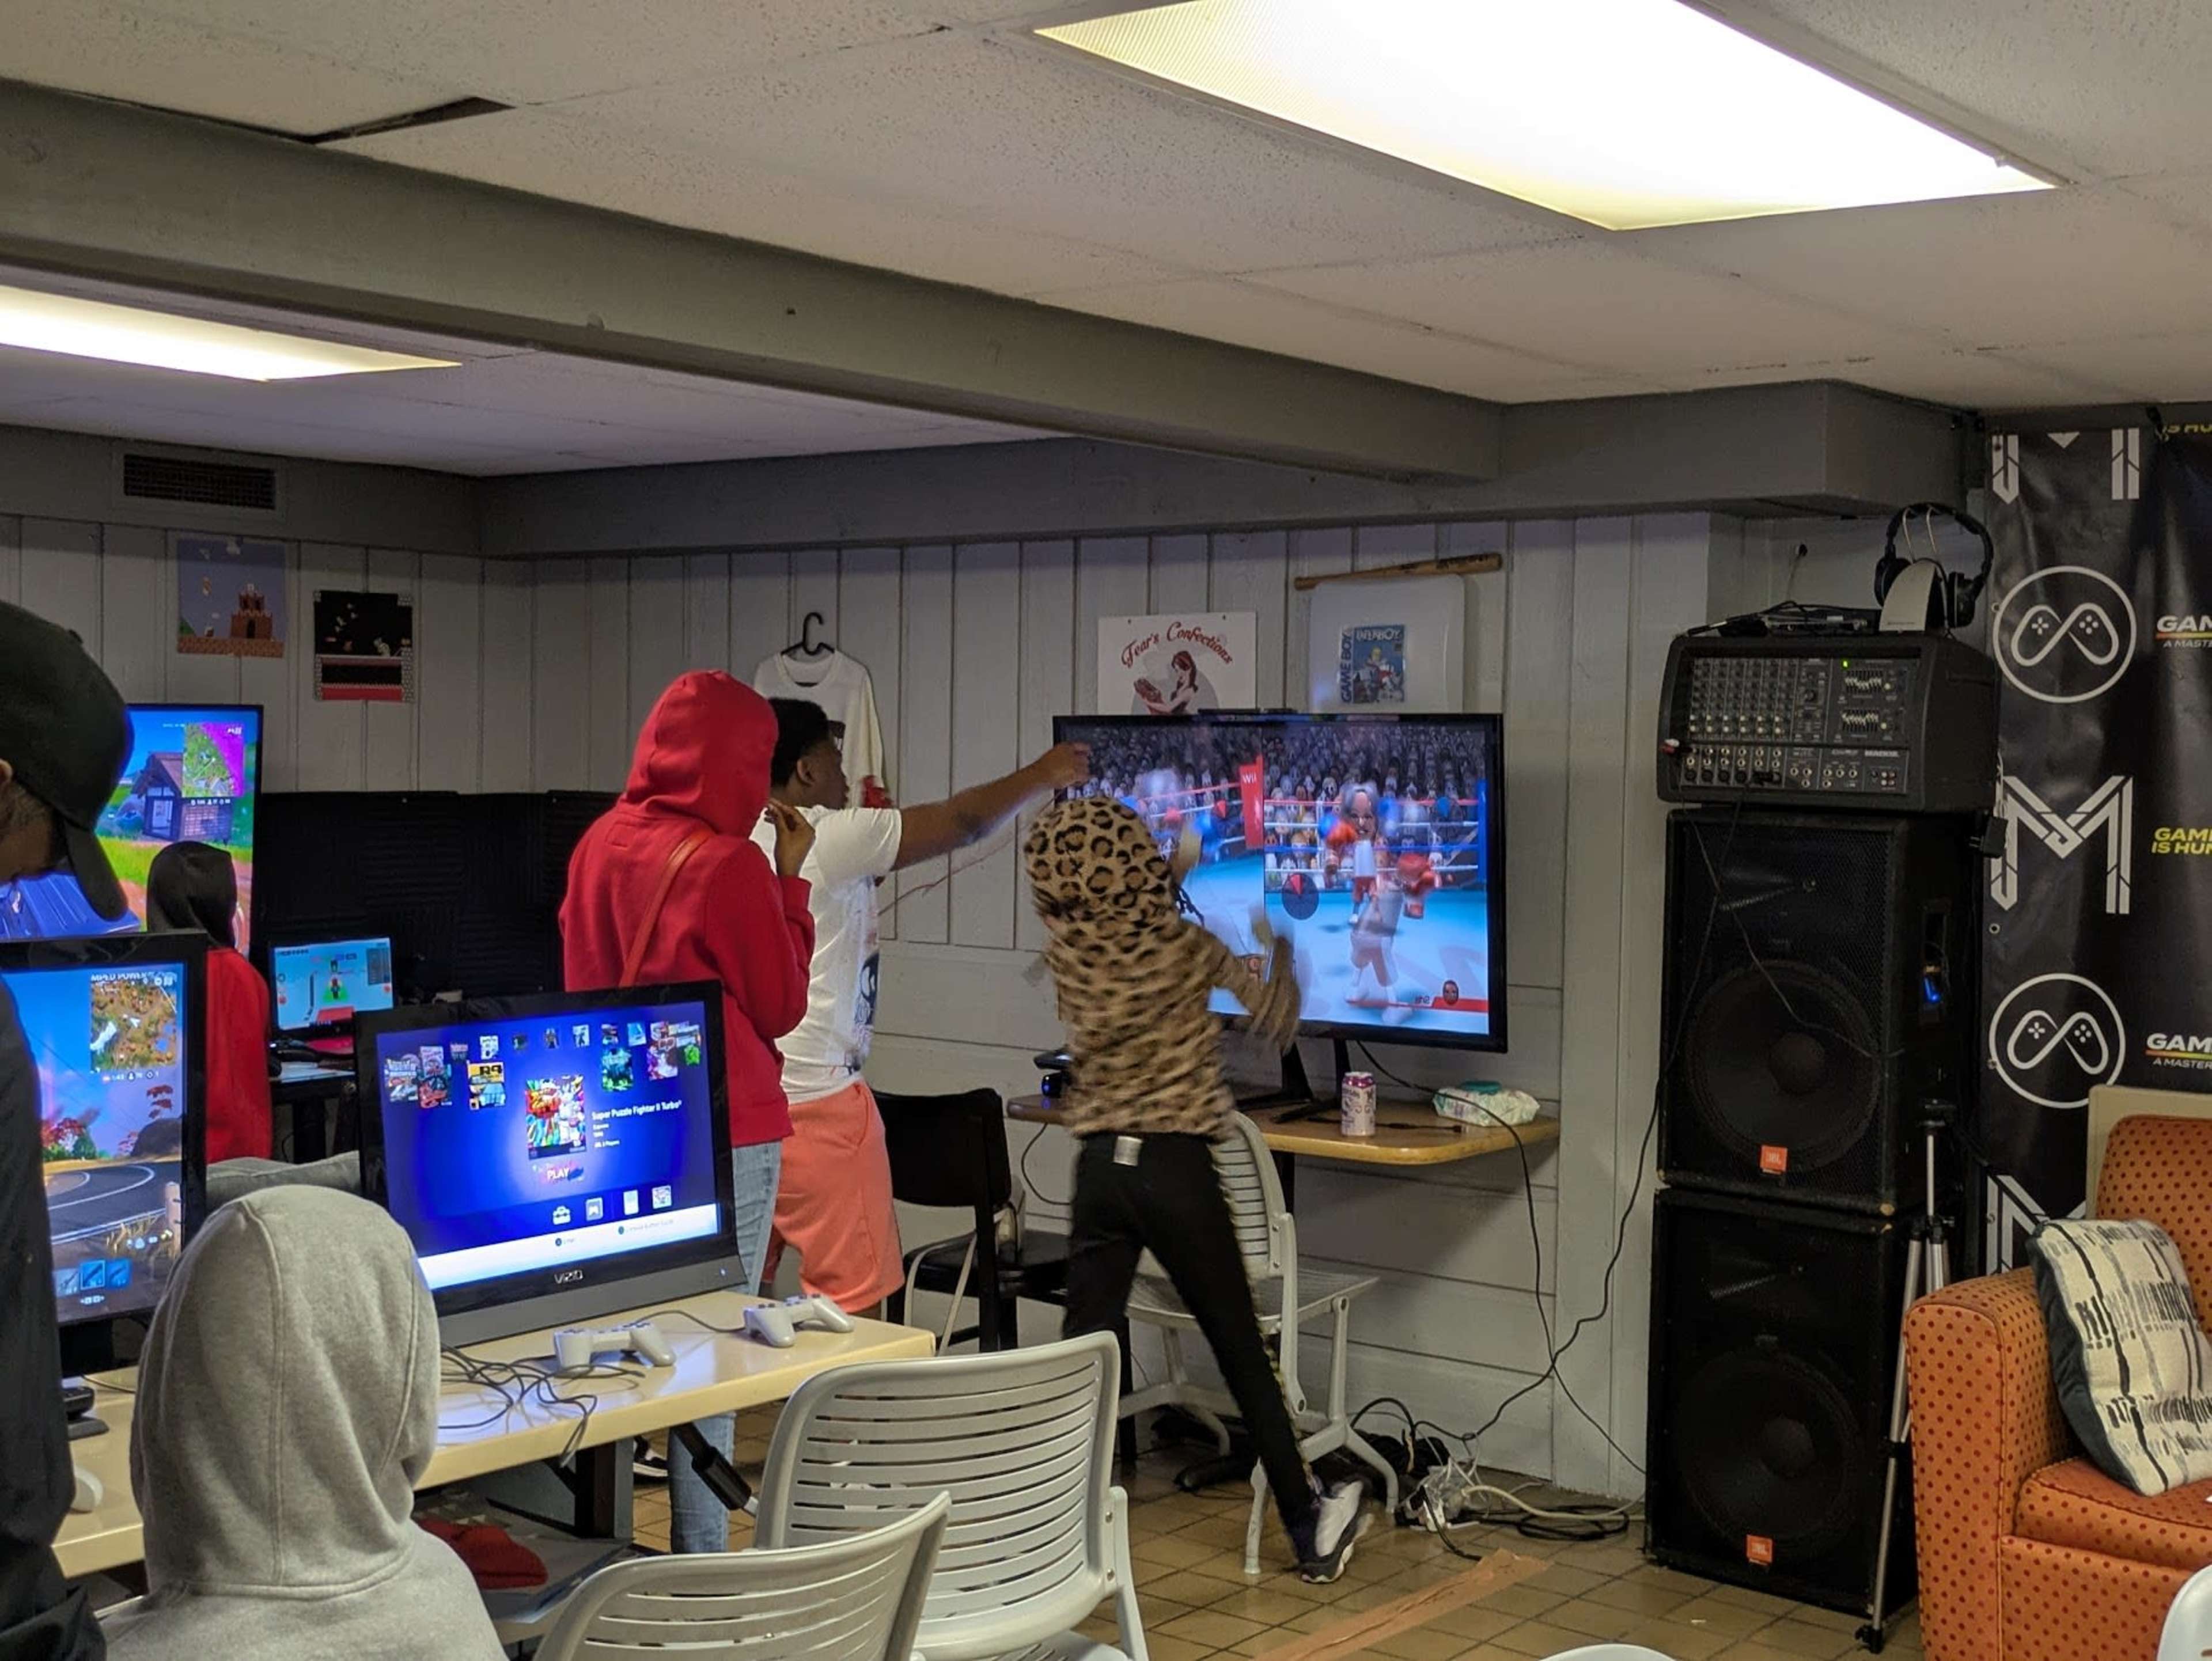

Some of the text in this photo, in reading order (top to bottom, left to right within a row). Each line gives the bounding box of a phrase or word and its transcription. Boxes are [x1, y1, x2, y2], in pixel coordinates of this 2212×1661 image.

[1166, 621, 1233, 664] Confections
[1340, 632, 1352, 703] GAME BOY
[2152, 841, 2171, 854] IS
[612, 1108, 632, 1118] Puzzle
[633, 1104, 656, 1116] Fighter
[547, 1167, 570, 1180] PLAY
[554, 1269, 584, 1284] VIZIO
